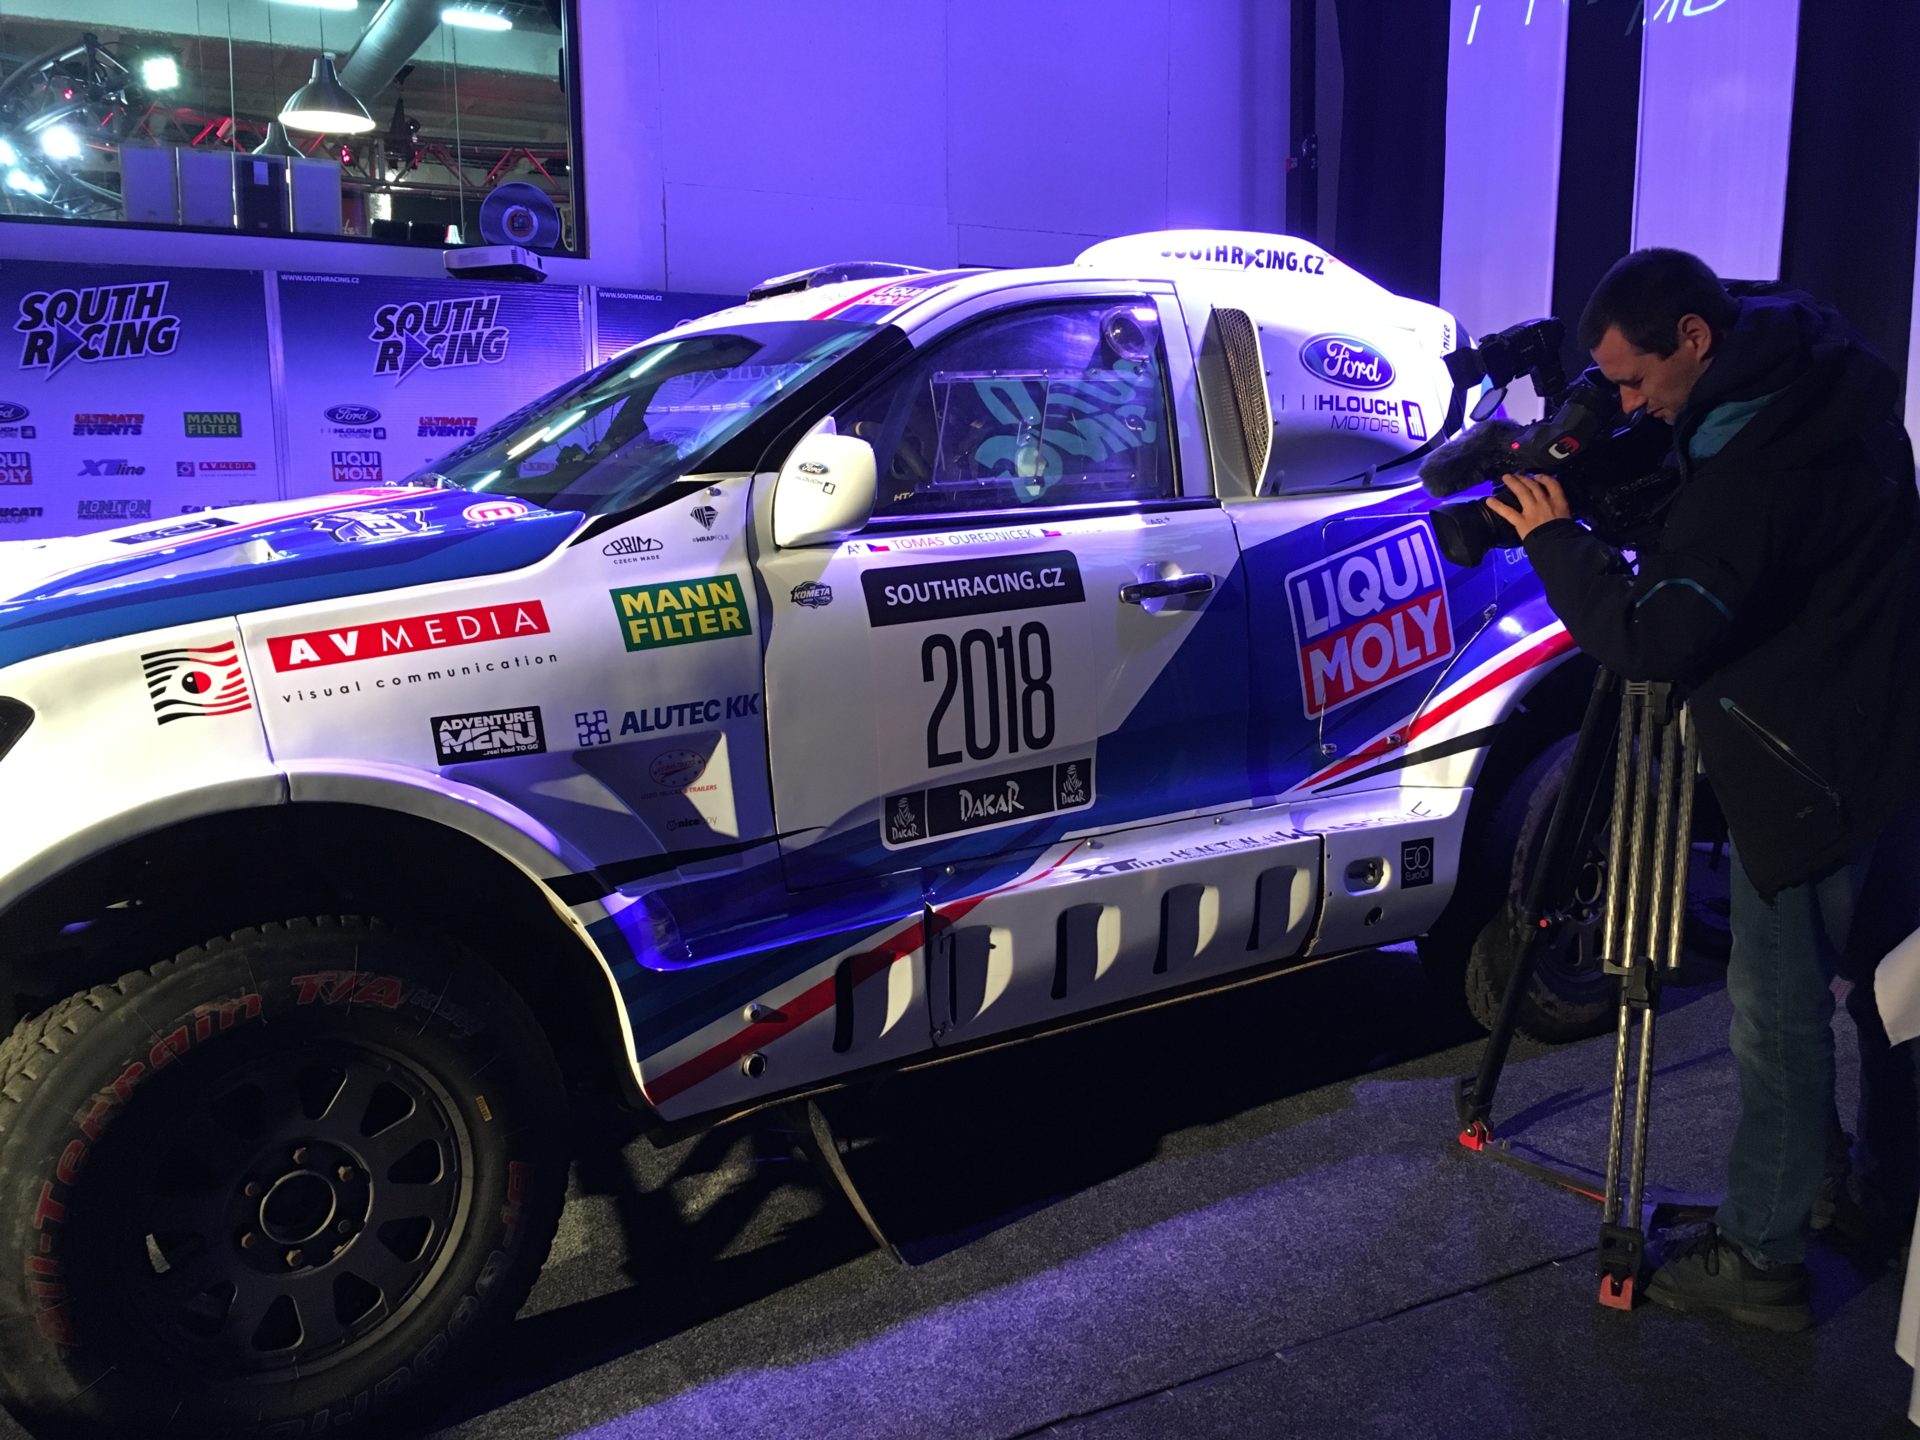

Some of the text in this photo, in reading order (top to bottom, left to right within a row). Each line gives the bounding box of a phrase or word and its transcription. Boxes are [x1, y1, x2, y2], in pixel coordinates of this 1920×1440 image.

[280, 274, 360, 284] WWW.SOUTHRACING.CZ
[599, 292, 663, 301] WWW.SOUTHRACING.CZ
[14, 282, 168, 331] SOUTH
[370, 295, 500, 341] SOUTH
[1322, 340, 1382, 383] Ford
[335, 407, 369, 421] Ford
[1318, 394, 1398, 416] HLOUCH
[74, 413, 144, 424] ULTIMATE
[187, 413, 237, 424] MANN
[419, 417, 478, 426] ULTIMATE
[1331, 415, 1400, 433] MOTORS
[73, 424, 143, 436] EVENTS
[188, 424, 238, 434] FILTER
[417, 426, 476, 437] EVENTS
[77, 459, 145, 476] XTline
[334, 453, 379, 467] LIQUI
[335, 467, 380, 481] MOLY
[77, 500, 151, 514] HONITON
[611, 535, 652, 554] PRIM
[891, 536, 945, 550] TOMAS
[948, 528, 1036, 545] OUREDNICEK
[613, 554, 660, 565] CZECH MADE
[793, 587, 831, 600] KOMETA
[884, 567, 1066, 606] SOUTHRACING.CZ
[1297, 532, 1435, 639] LIQUI
[620, 581, 737, 617] MANN
[628, 607, 744, 644] FILTER
[1308, 594, 1442, 706] MOLY
[282, 652, 558, 704] visual communication
[921, 621, 1056, 769] 2018
[439, 711, 535, 732] ADVENTURE
[619, 693, 760, 735] ALUTEC KK
[439, 721, 538, 754] MENU
[689, 784, 717, 793] TRAILERS
[1060, 789, 1086, 805] DAKAR
[958, 780, 1025, 822] DAKAR
[891, 823, 920, 841] DAKAR
[1073, 858, 1174, 879] XTline
